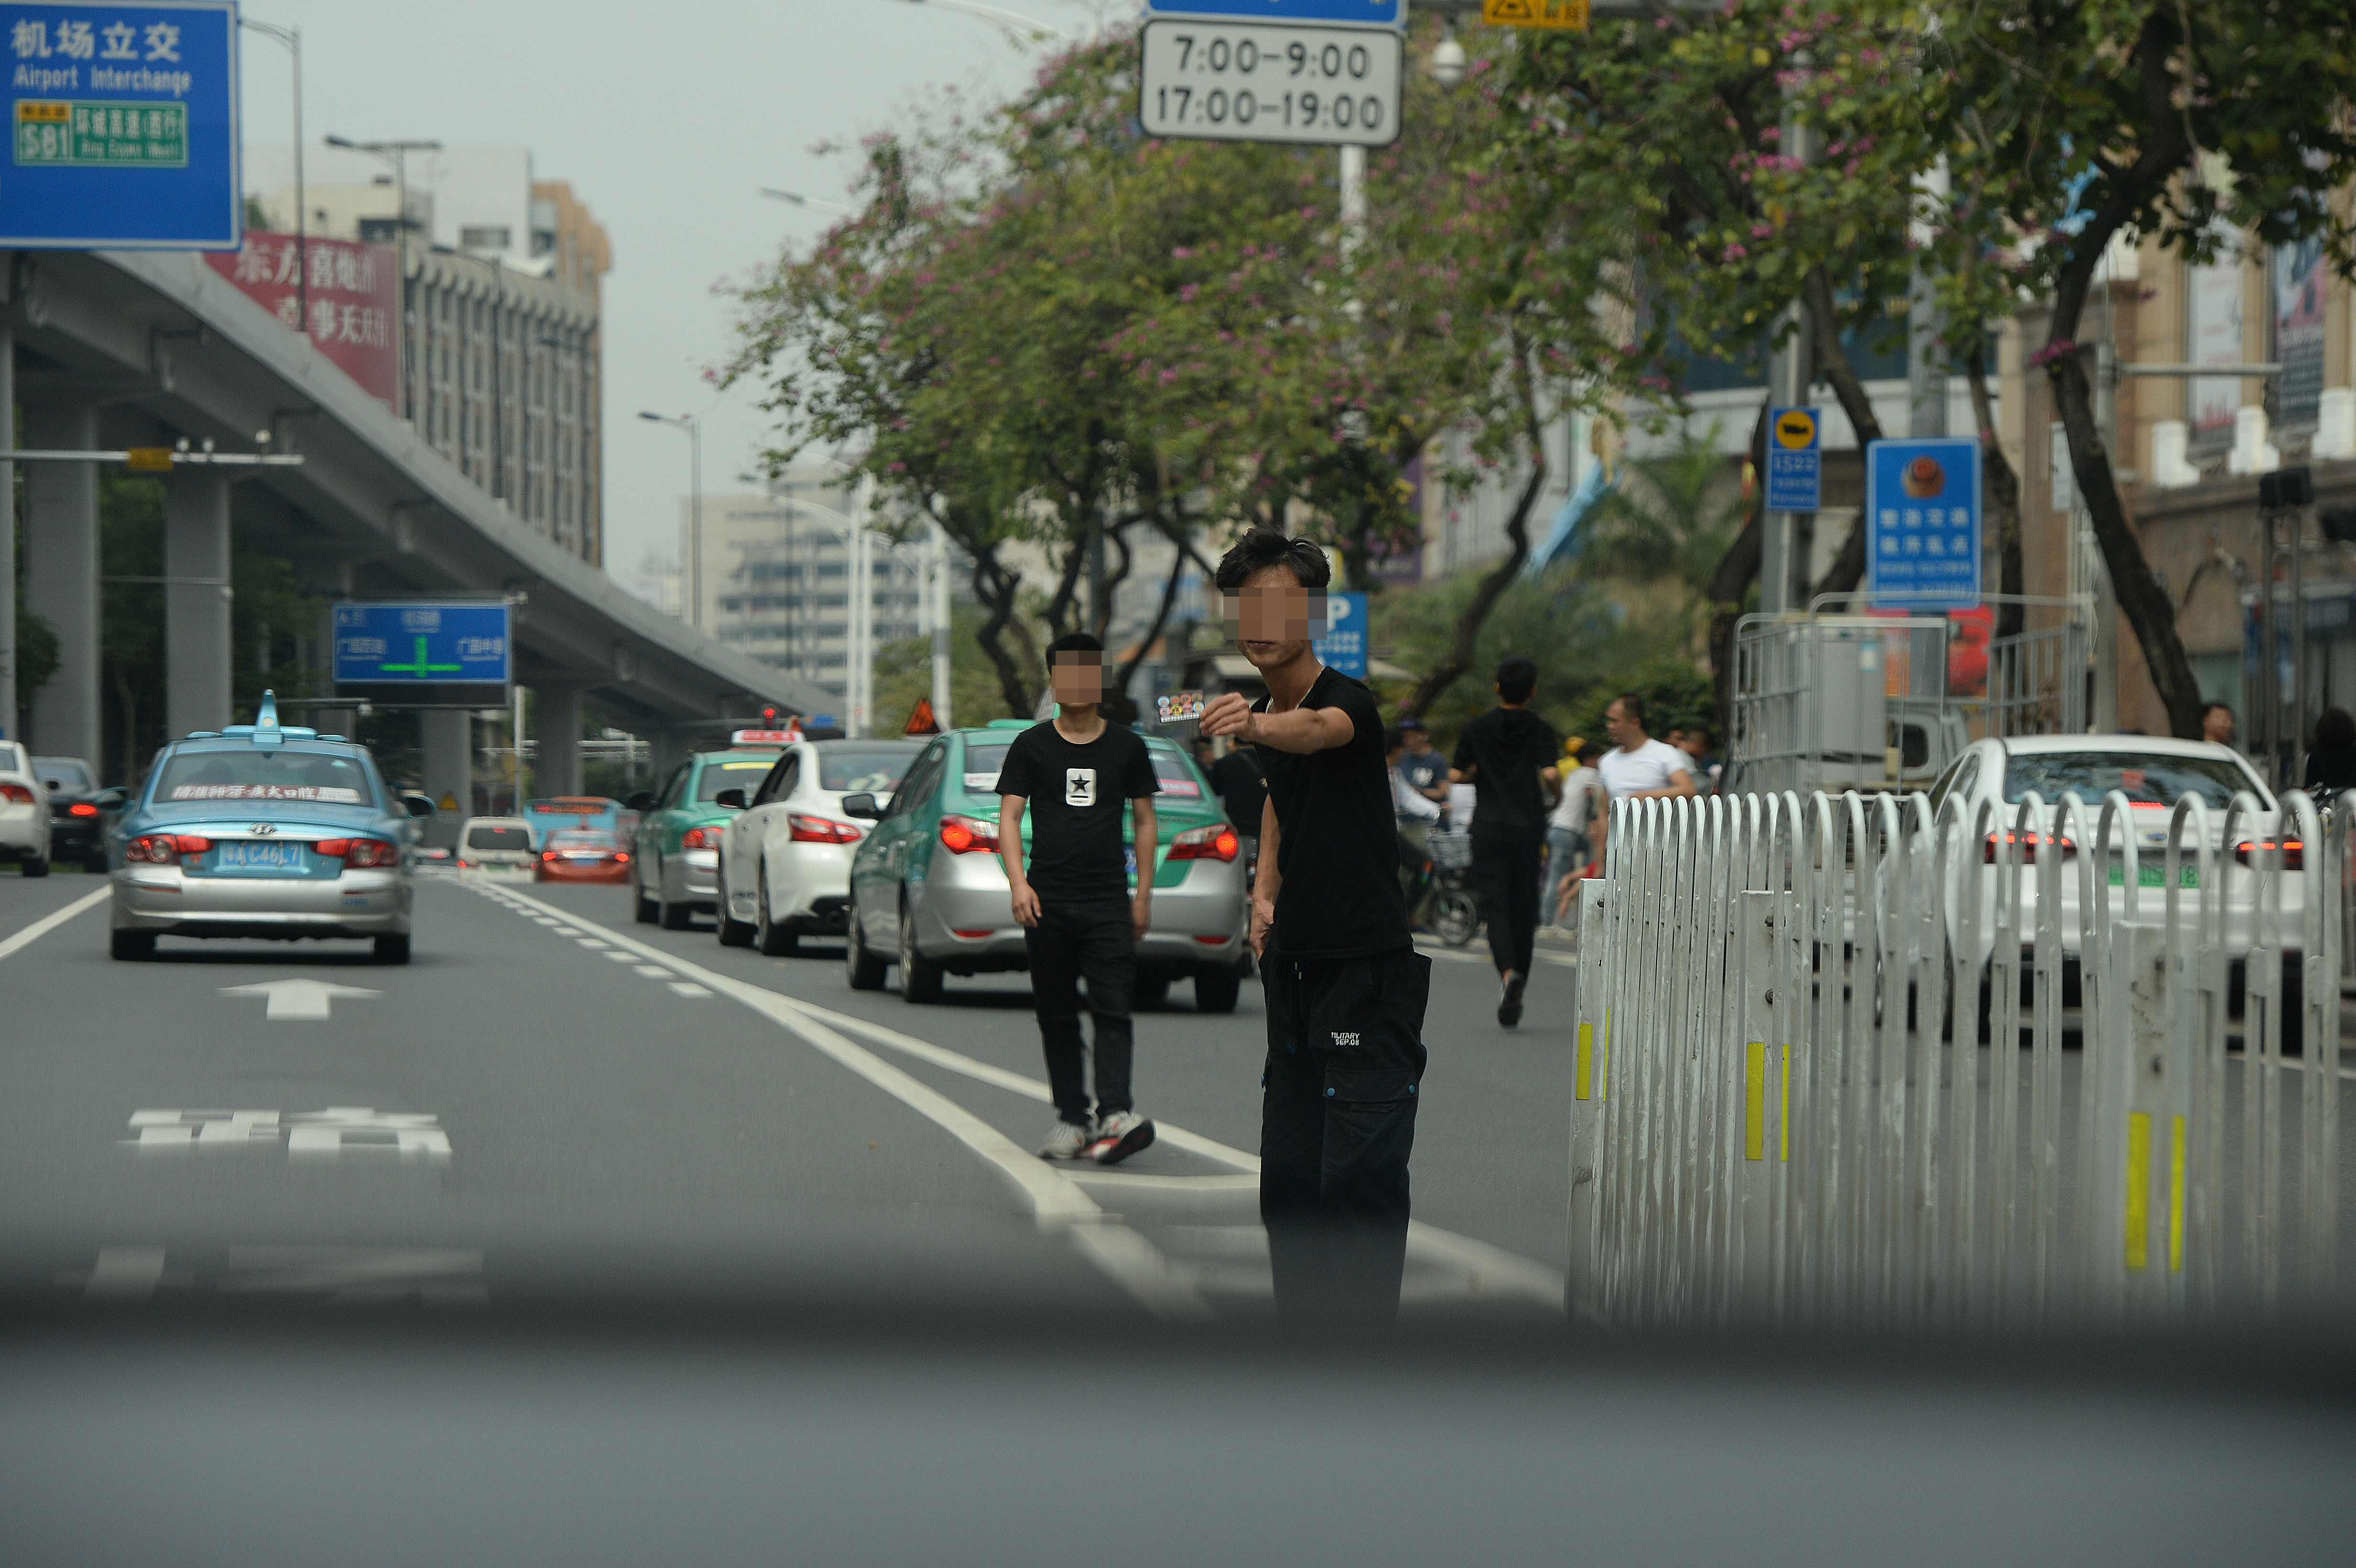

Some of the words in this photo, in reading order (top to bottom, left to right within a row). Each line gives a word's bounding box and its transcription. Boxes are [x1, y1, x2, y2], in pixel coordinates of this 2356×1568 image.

[11, 19, 181, 63] 机场立交
[12, 64, 78, 94] Airport
[91, 65, 191, 98] Interchange
[22, 123, 68, 160] S81
[1327, 596, 1352, 632] P
